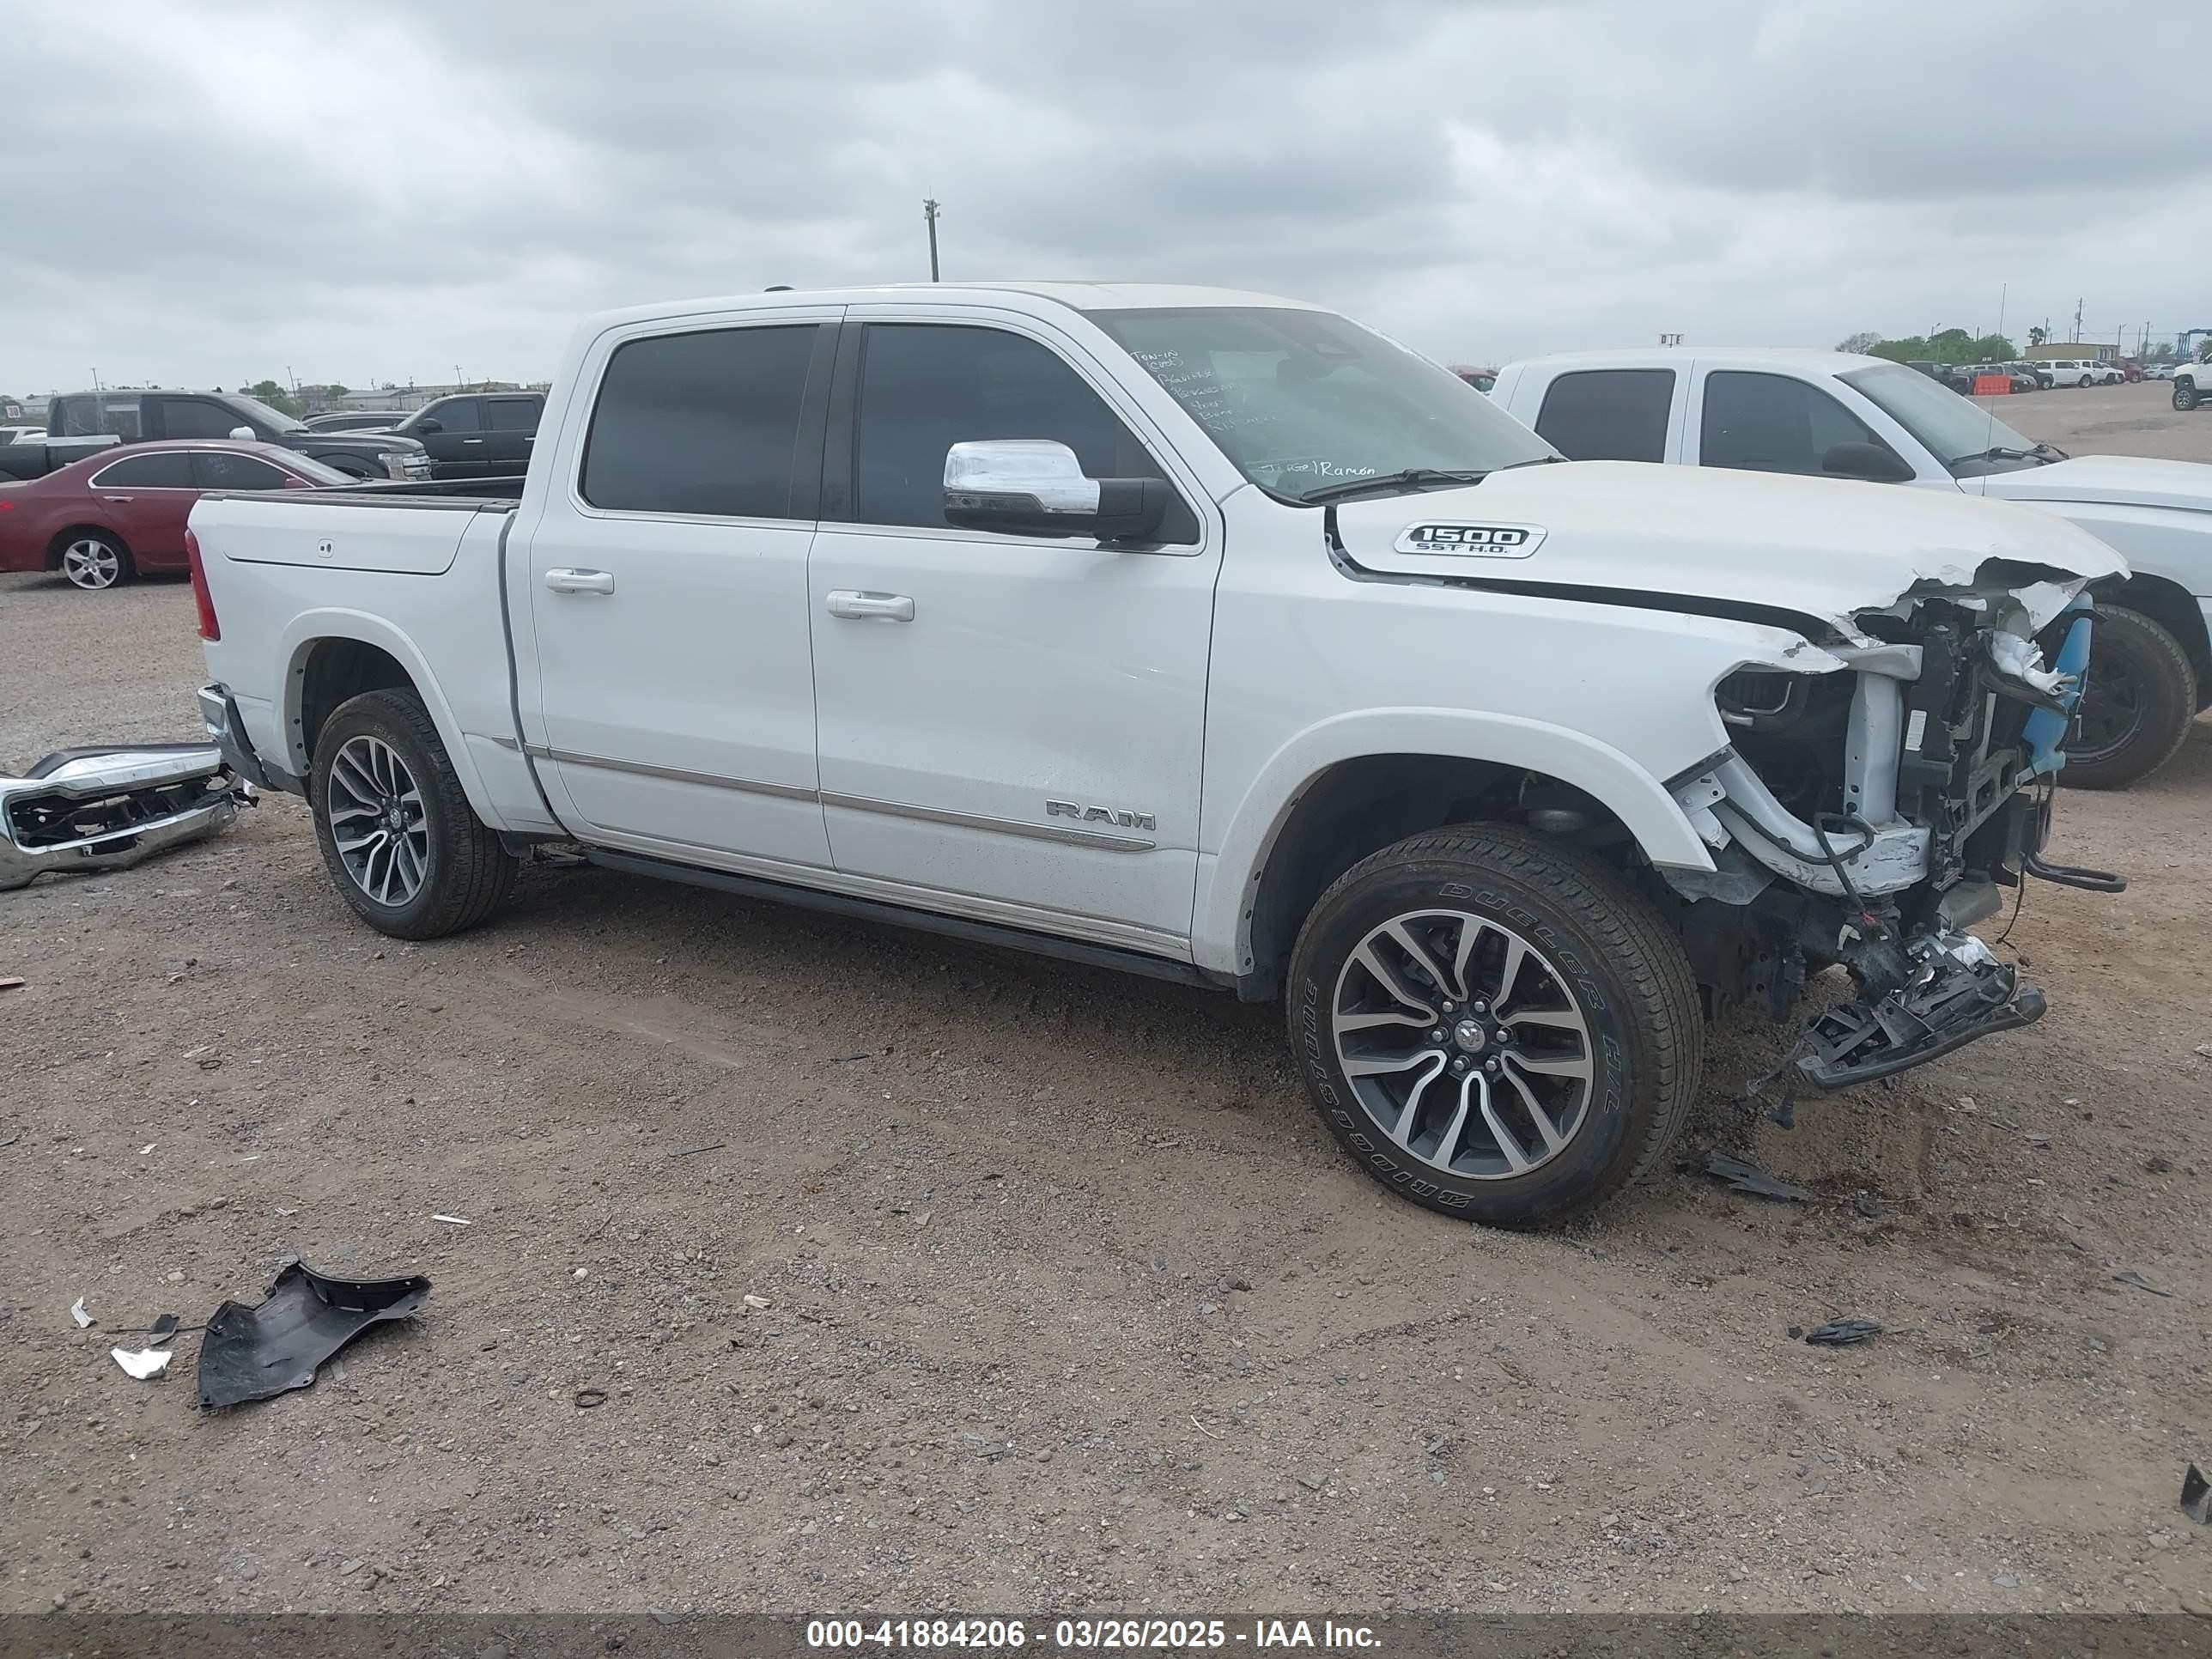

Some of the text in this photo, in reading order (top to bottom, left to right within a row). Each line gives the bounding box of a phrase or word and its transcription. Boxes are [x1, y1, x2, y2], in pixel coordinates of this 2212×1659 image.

[1415, 543, 1508, 553] SST H.O.
[1421, 527, 1522, 544] 1500
[1046, 799, 1157, 830] RAM
[1438, 882, 1622, 1115] DUELER H/L
[1304, 978, 1476, 1209] BRIDGESTONE
